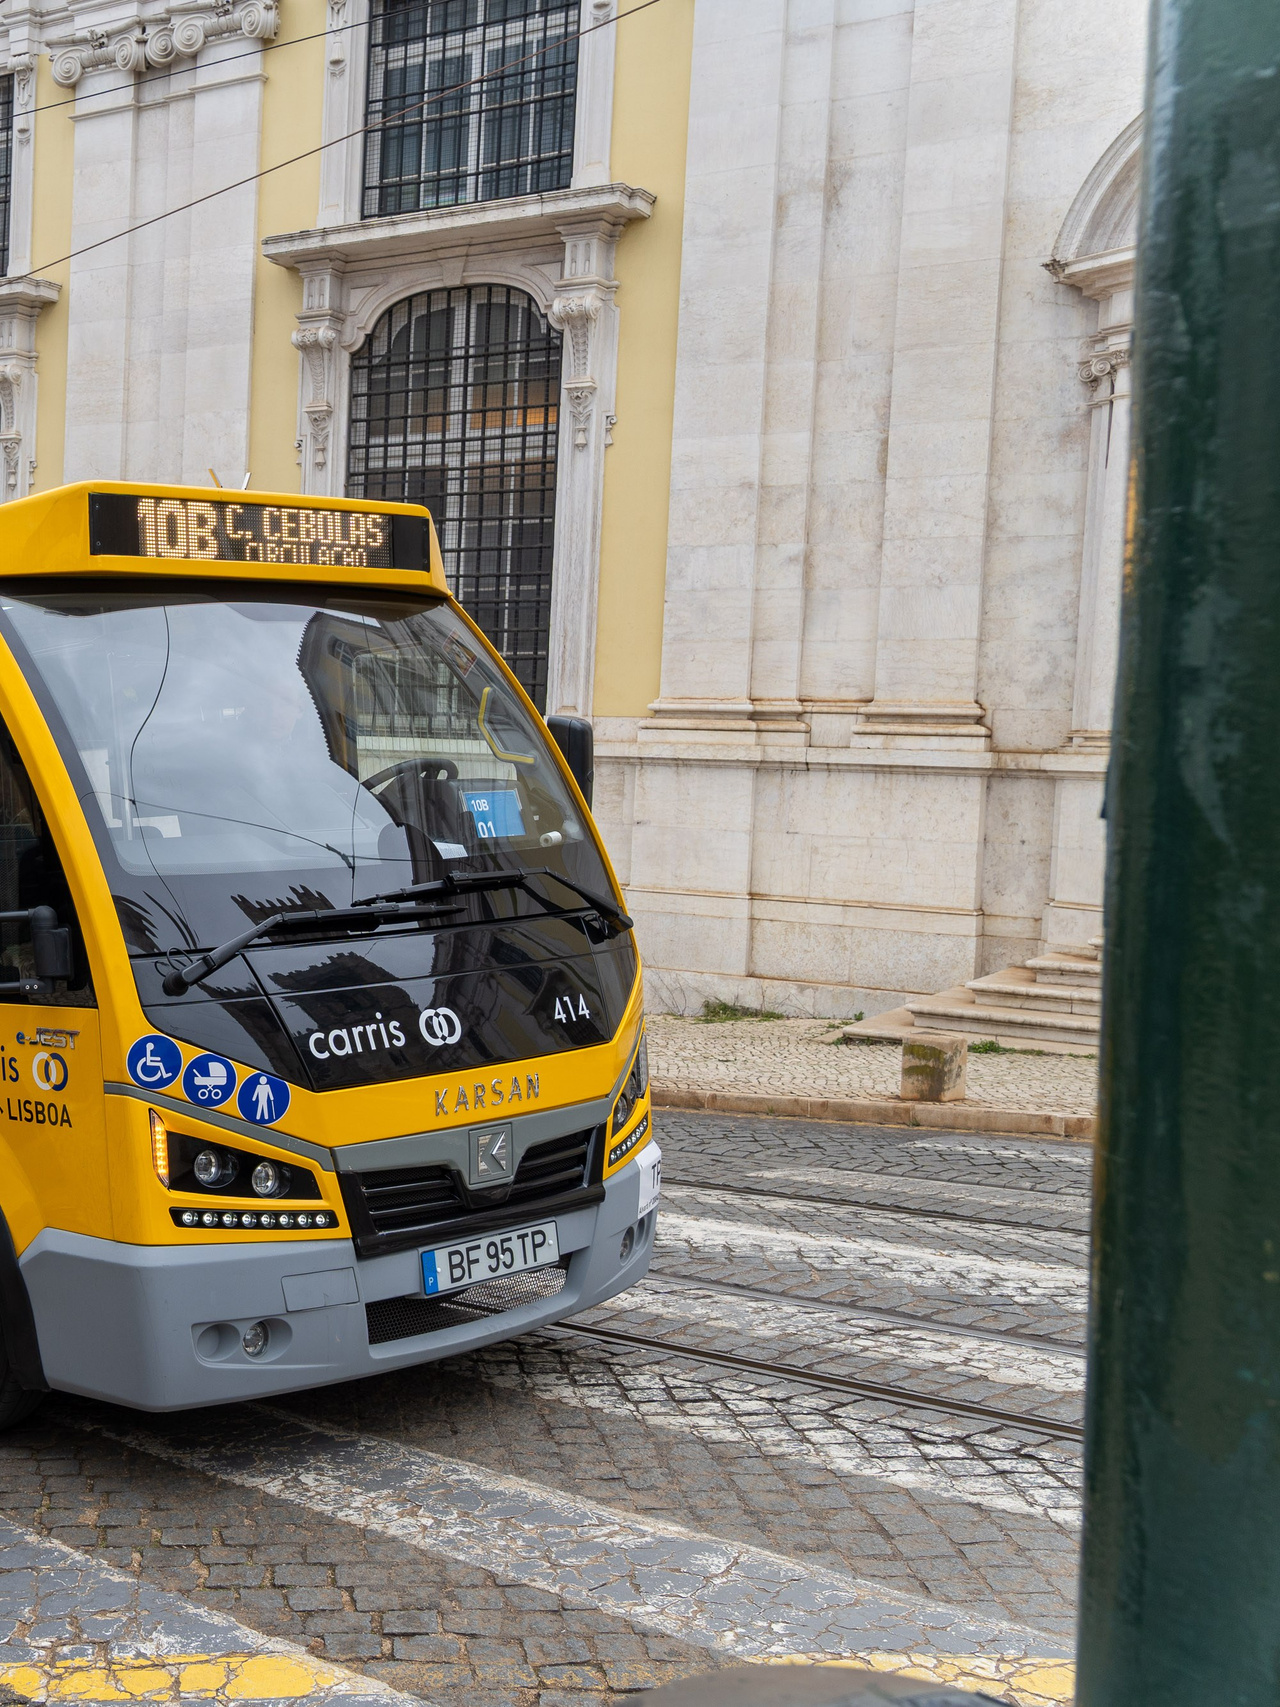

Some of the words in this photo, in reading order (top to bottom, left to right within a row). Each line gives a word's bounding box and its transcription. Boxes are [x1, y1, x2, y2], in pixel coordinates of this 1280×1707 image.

[138, 498, 218, 559] 10B
[263, 507, 383, 547] CEBOLAS
[471, 799, 489, 811] 10B
[477, 821, 496, 838] 01
[554, 993, 590, 1024] 414
[308, 1012, 406, 1059] carris
[7, 1098, 72, 1128] LISBOA
[435, 1072, 540, 1117] KARSAN
[447, 1244, 481, 1284] BF
[486, 1236, 515, 1273] 95
[516, 1230, 546, 1265] TP
